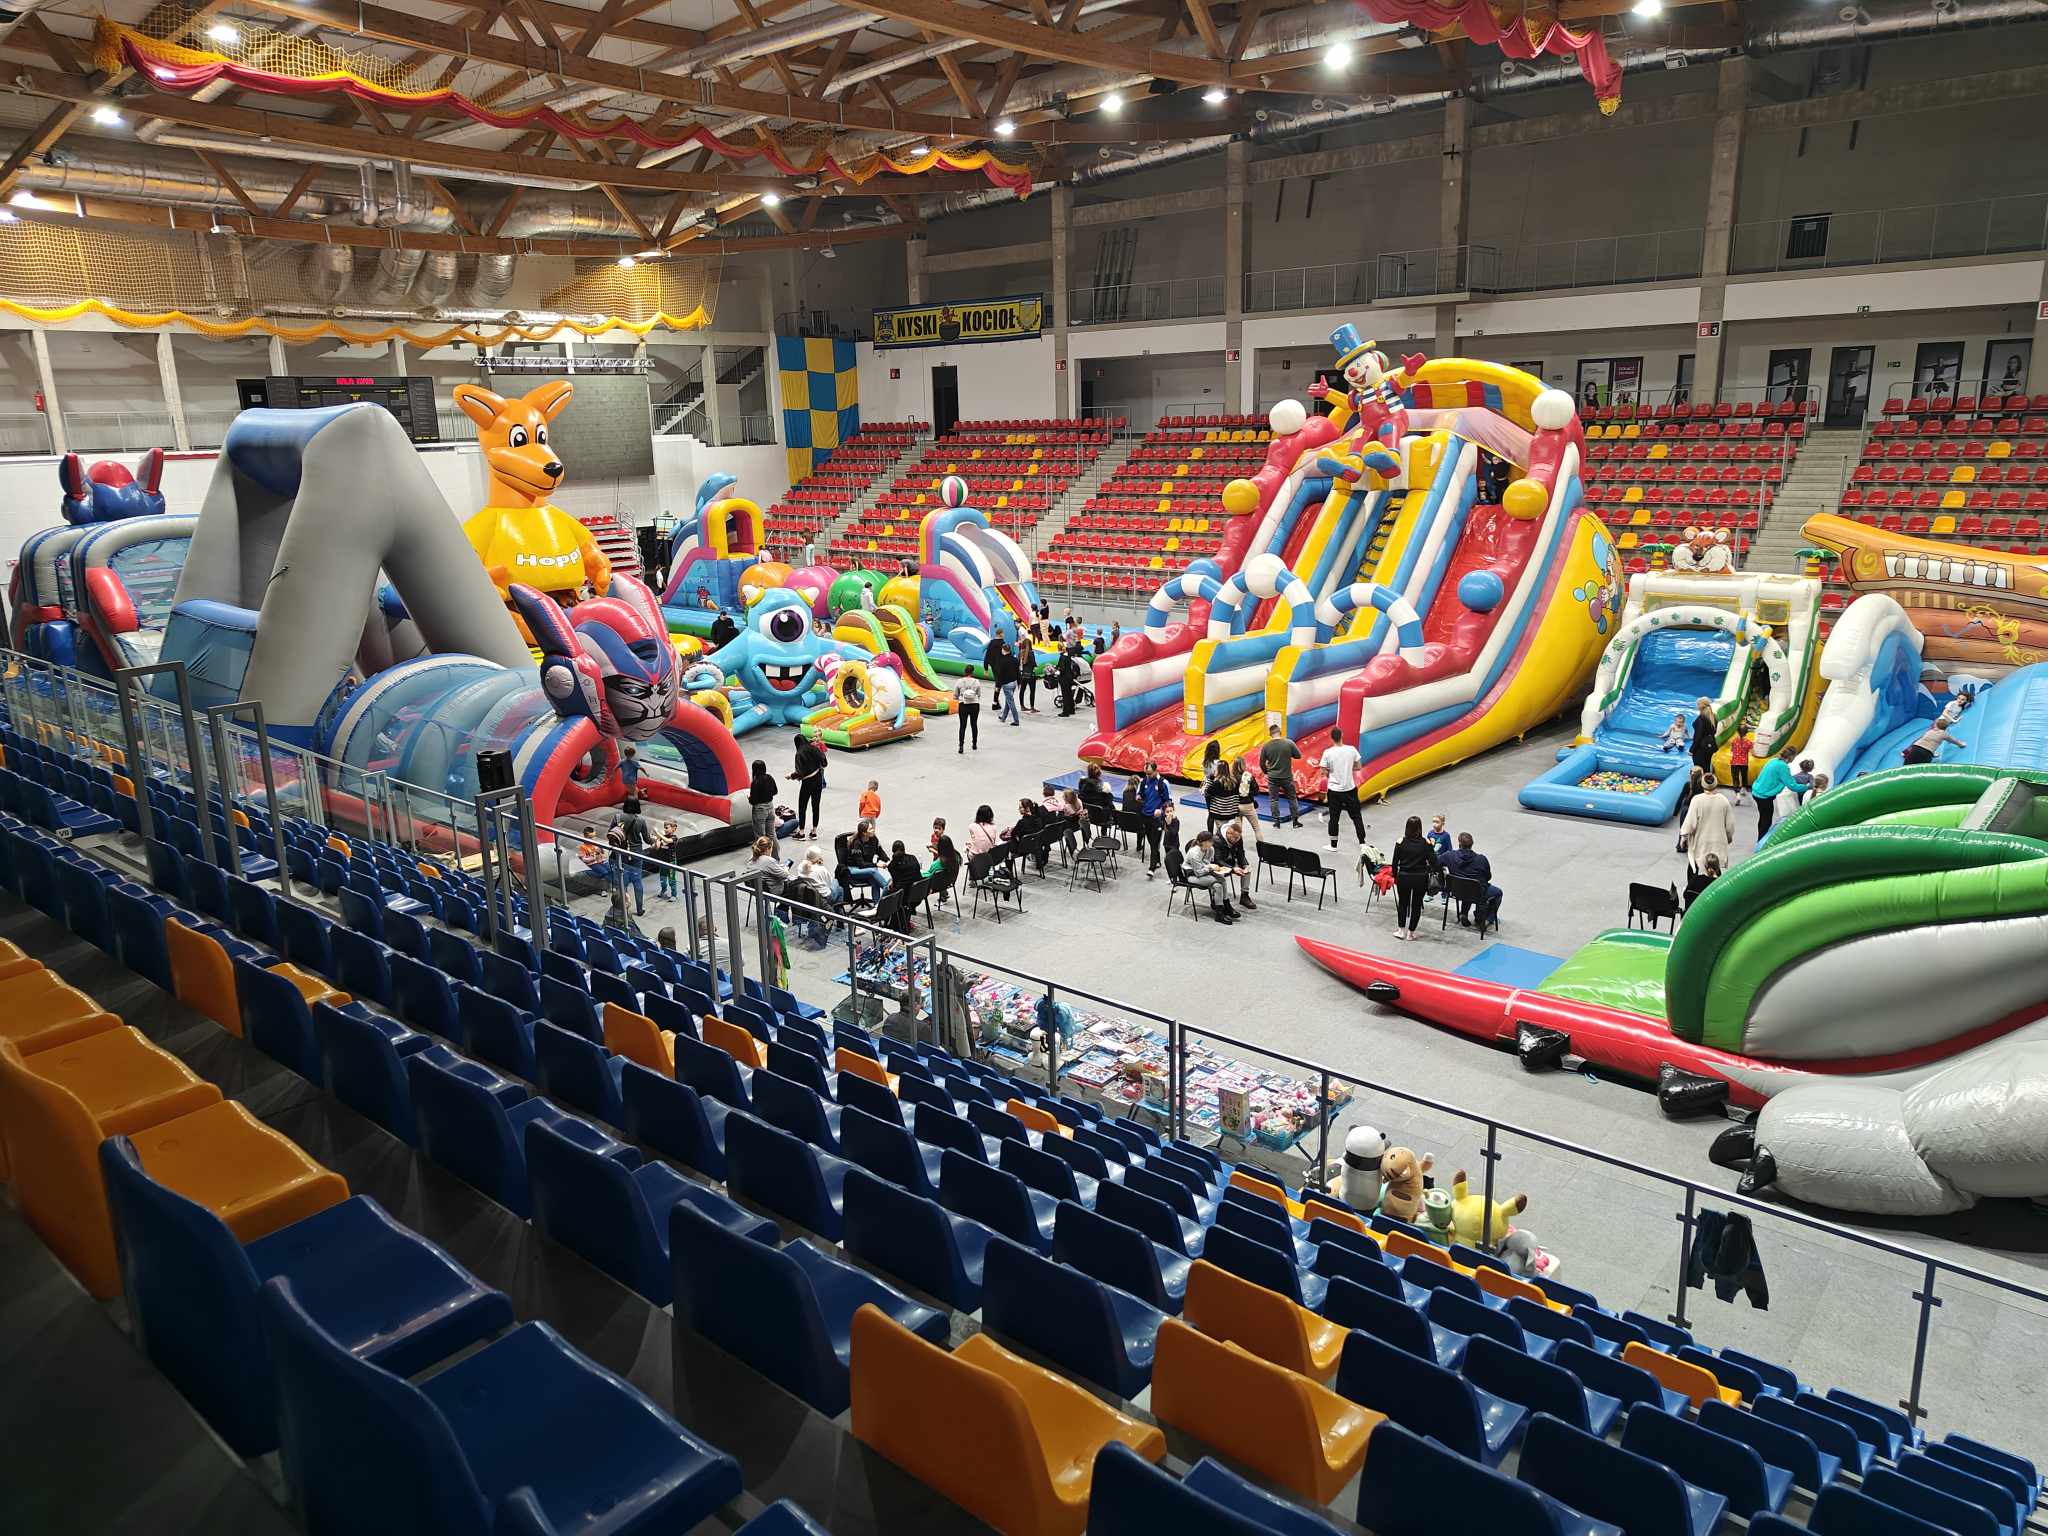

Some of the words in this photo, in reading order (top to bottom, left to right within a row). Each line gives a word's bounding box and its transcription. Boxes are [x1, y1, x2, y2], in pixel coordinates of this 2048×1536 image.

[897, 314, 937, 337] NYSKI
[962, 308, 1016, 332] KOCIOŁ
[1701, 327, 1708, 336] B
[1711, 327, 1718, 335] 3
